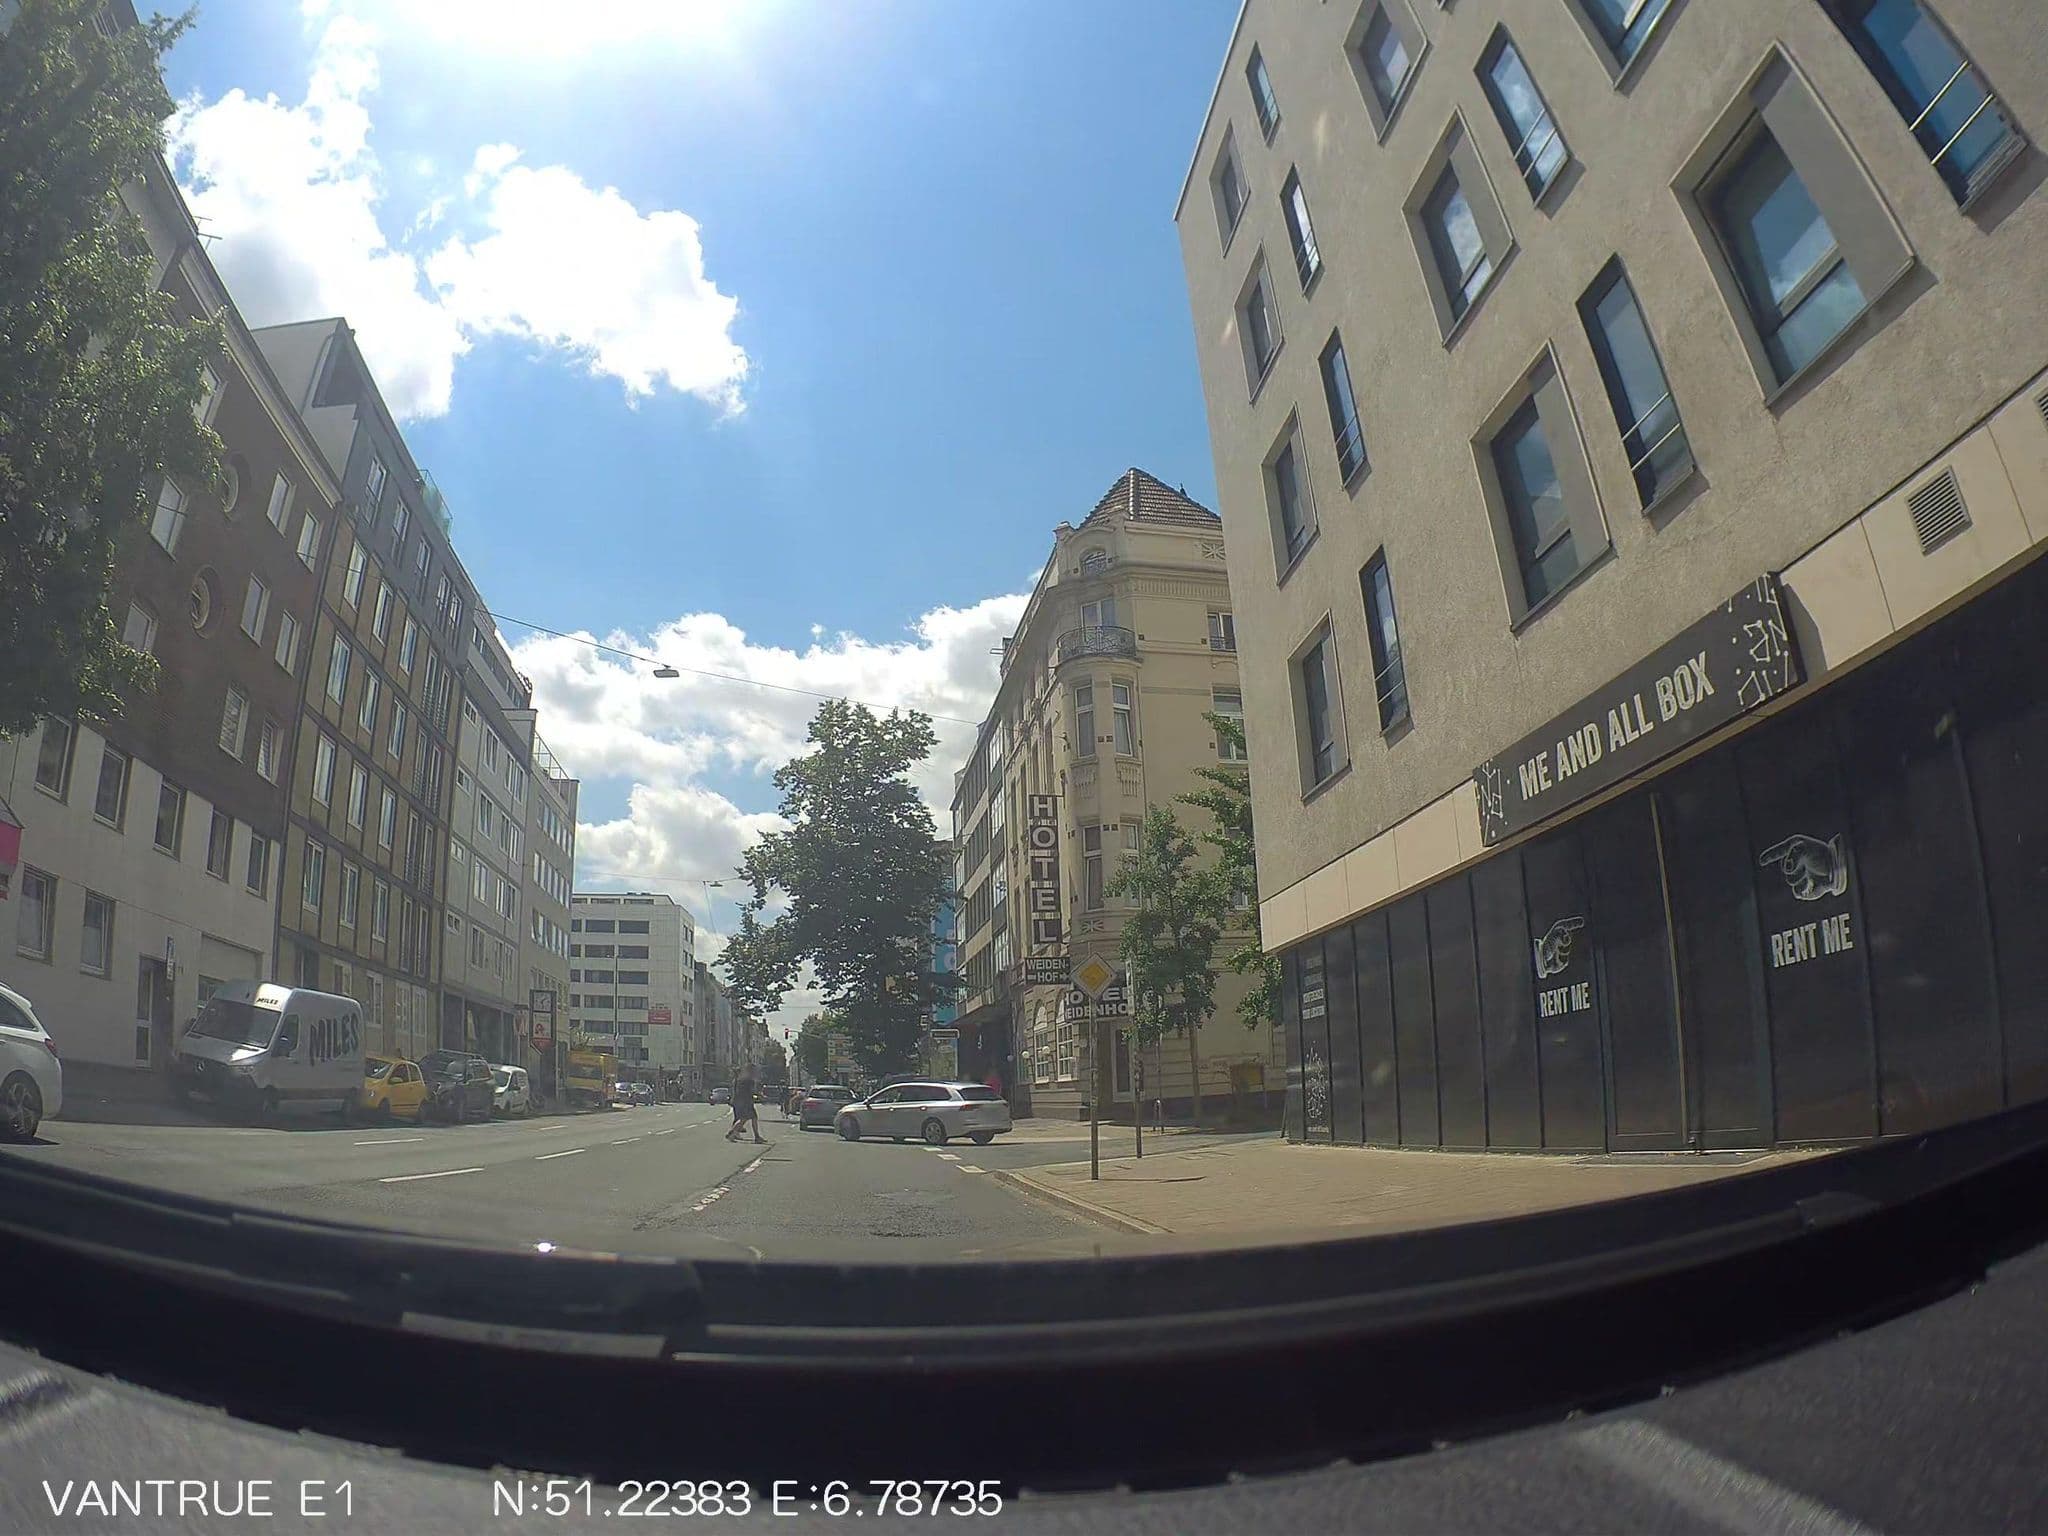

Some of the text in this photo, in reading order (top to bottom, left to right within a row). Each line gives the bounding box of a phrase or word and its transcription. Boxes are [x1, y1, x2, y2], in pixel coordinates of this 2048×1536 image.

[1518, 651, 1715, 801] ME AND ALL BOX
[1031, 795, 1059, 943] HOTEL
[1770, 913, 1854, 968] RENT ME
[1539, 982, 1591, 1018] RENT ME
[309, 1013, 360, 1066] MILES
